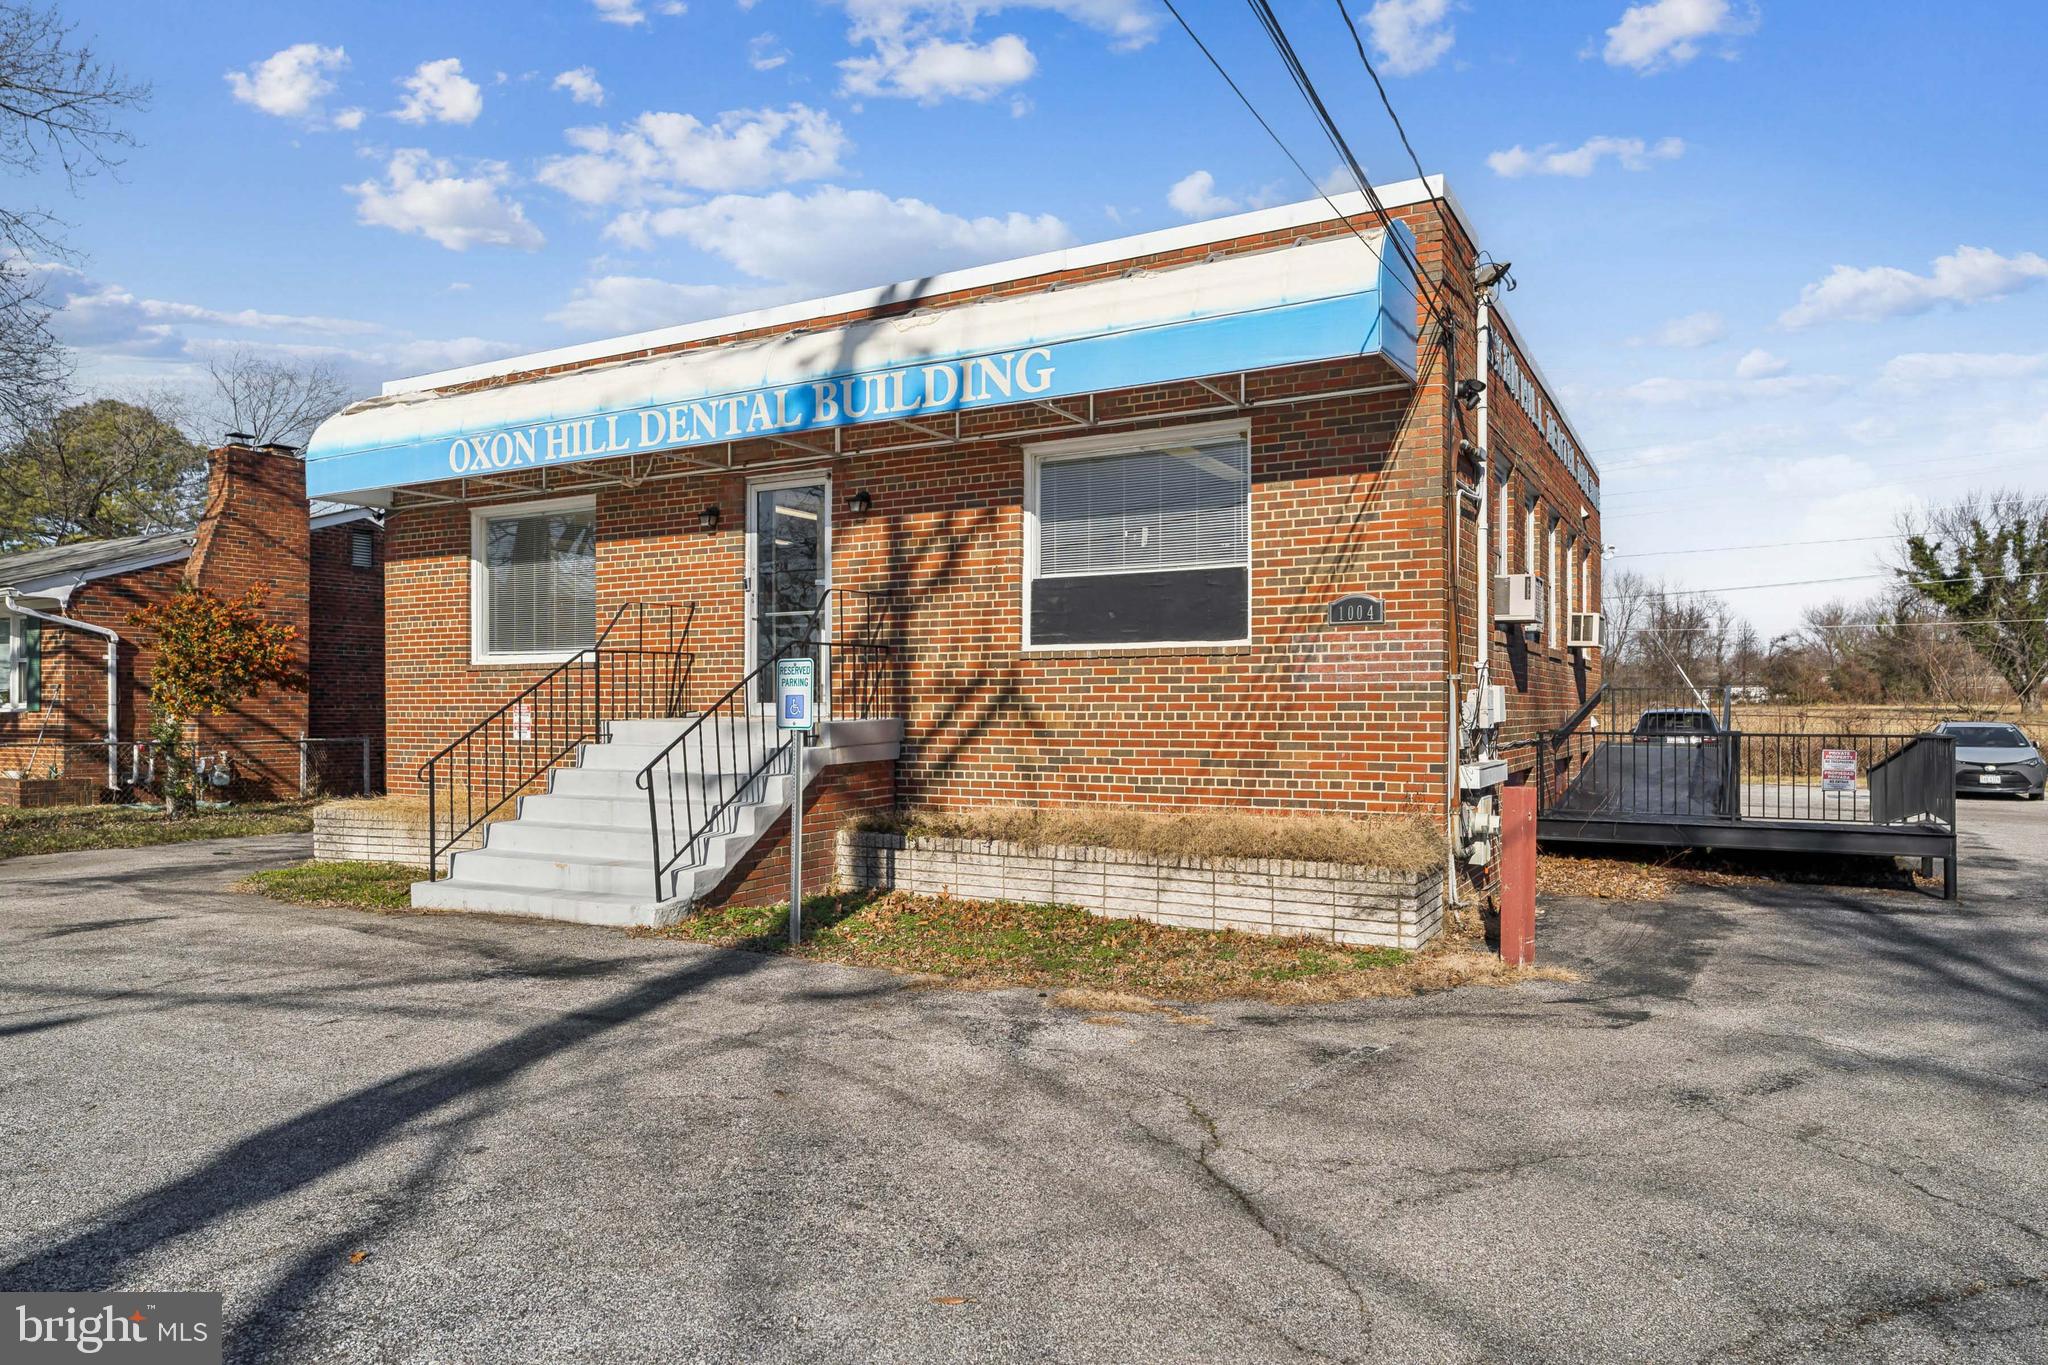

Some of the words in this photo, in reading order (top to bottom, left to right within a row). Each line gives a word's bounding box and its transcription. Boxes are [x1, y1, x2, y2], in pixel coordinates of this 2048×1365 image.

[449, 427, 535, 474] OXON
[545, 415, 631, 460] HILL
[637, 390, 803, 448] DENTAL
[813, 348, 1055, 423] BUILDING
[1339, 604, 1374, 621] 1004
[779, 666, 810, 675] RESERVED
[781, 678, 809, 687] PARKING
